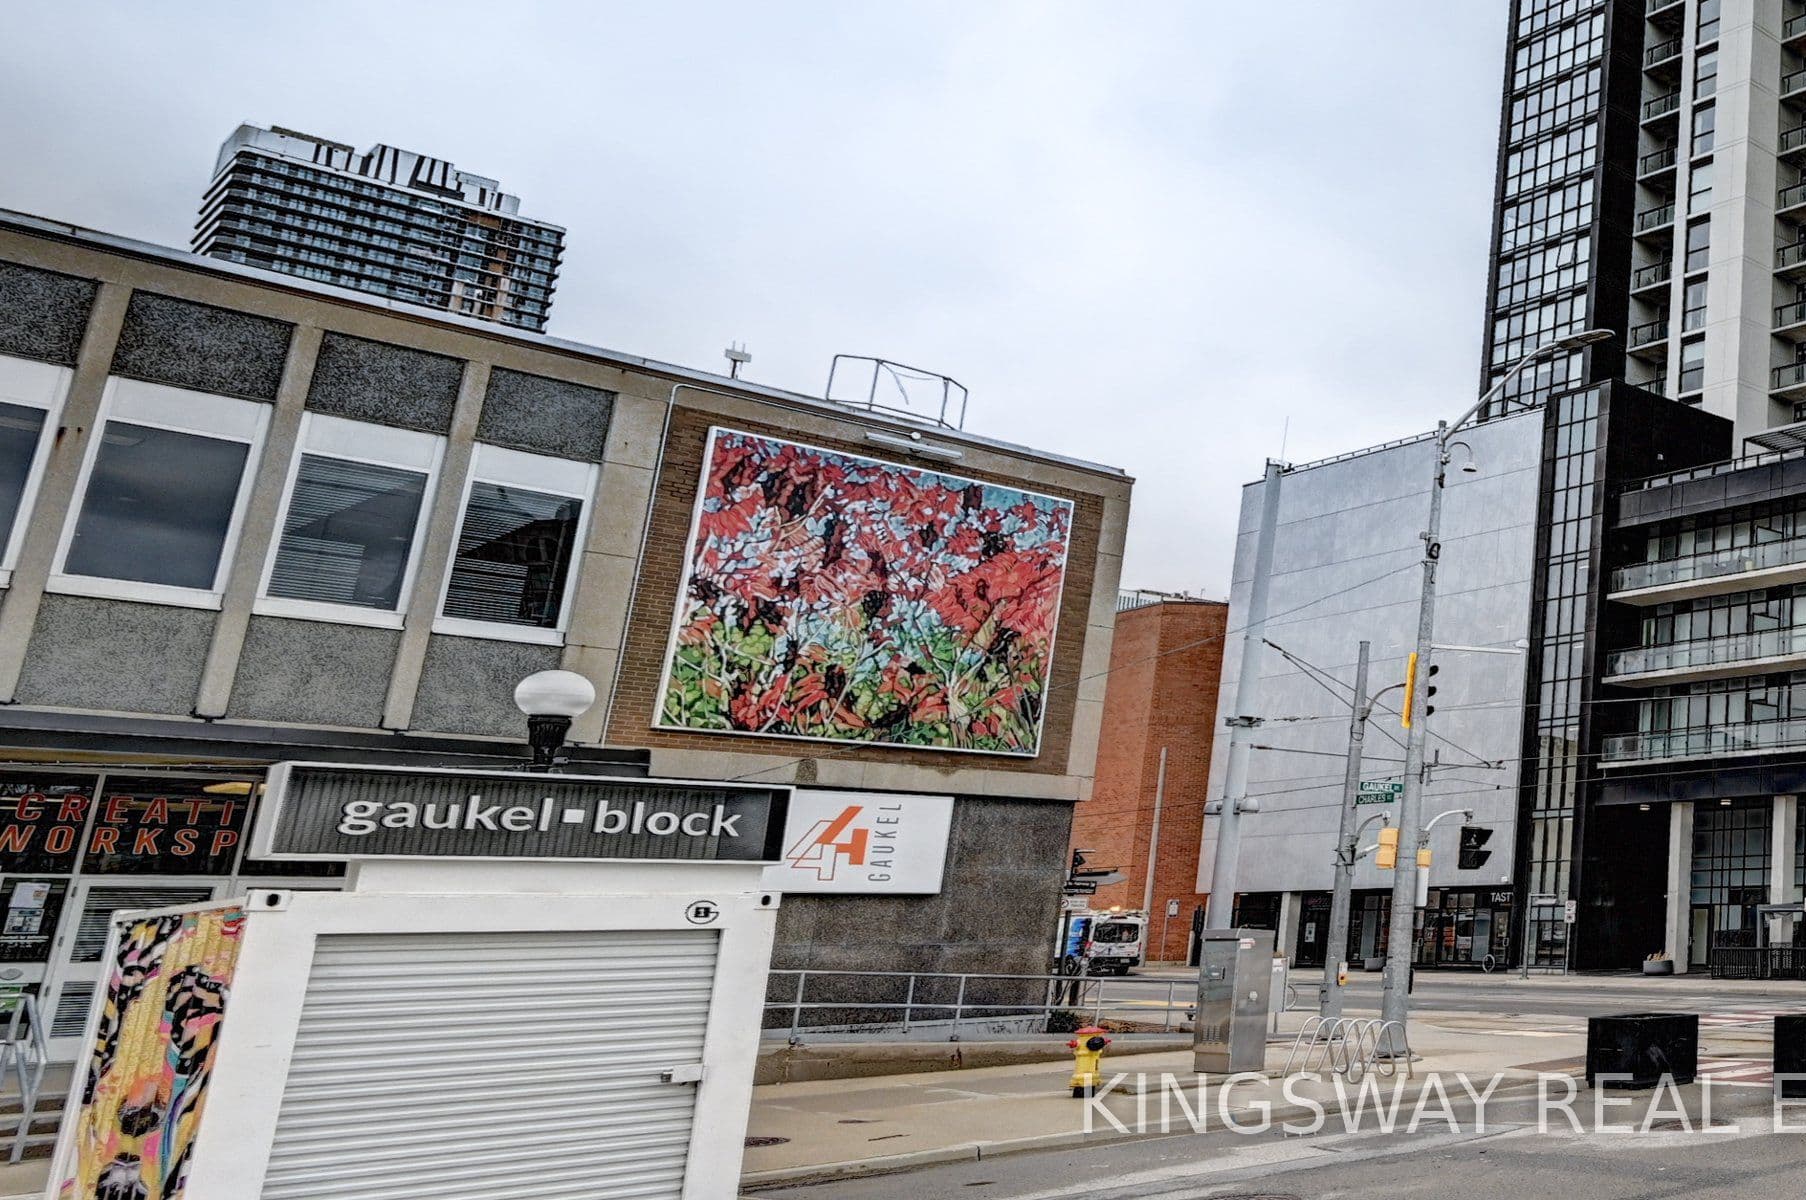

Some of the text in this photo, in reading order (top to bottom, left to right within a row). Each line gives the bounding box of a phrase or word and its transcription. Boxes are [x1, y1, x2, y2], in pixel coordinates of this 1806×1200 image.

[336, 795, 742, 837] gaukel block
[868, 803, 902, 882] GAUKEL
[1490, 892, 1513, 902] TAST
